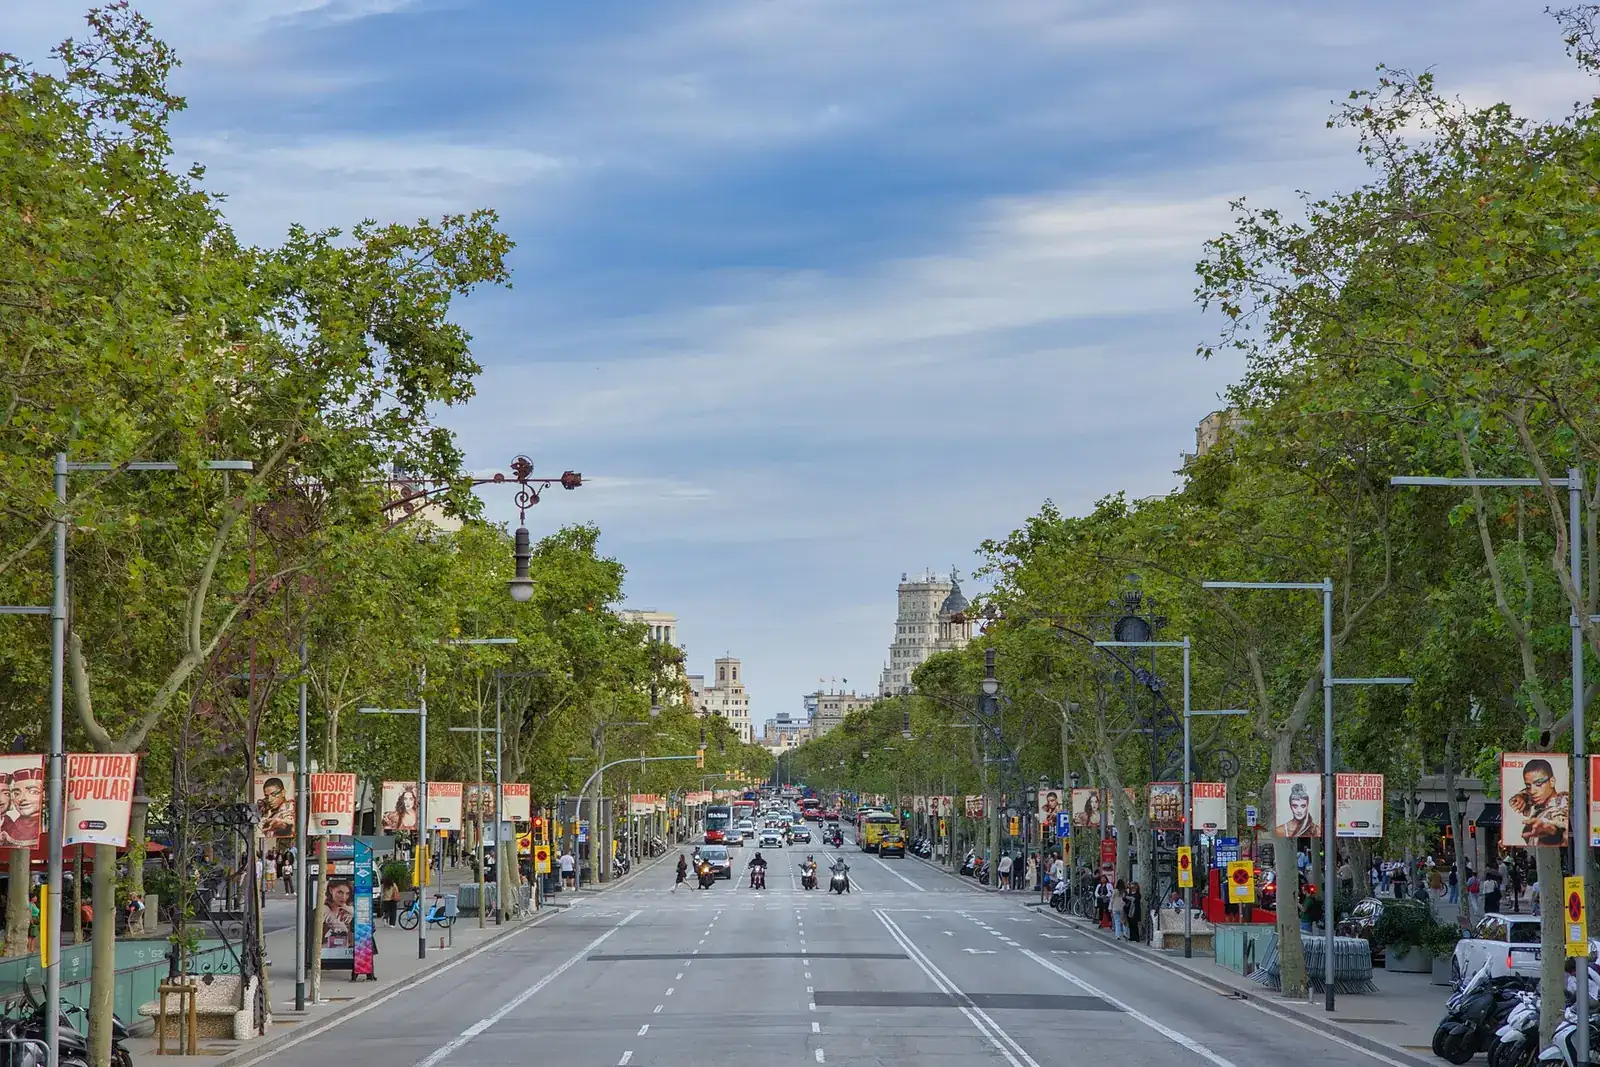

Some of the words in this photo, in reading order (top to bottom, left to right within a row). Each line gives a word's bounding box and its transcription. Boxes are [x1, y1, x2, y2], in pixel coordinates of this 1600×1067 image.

[69, 755, 132, 778] CULTURA
[1363, 775, 1382, 787] ARTS
[68, 778, 131, 802] POPULAR
[1338, 787, 1348, 801] DE
[1349, 787, 1382, 801] CARRER
[1060, 814, 1069, 828] P
